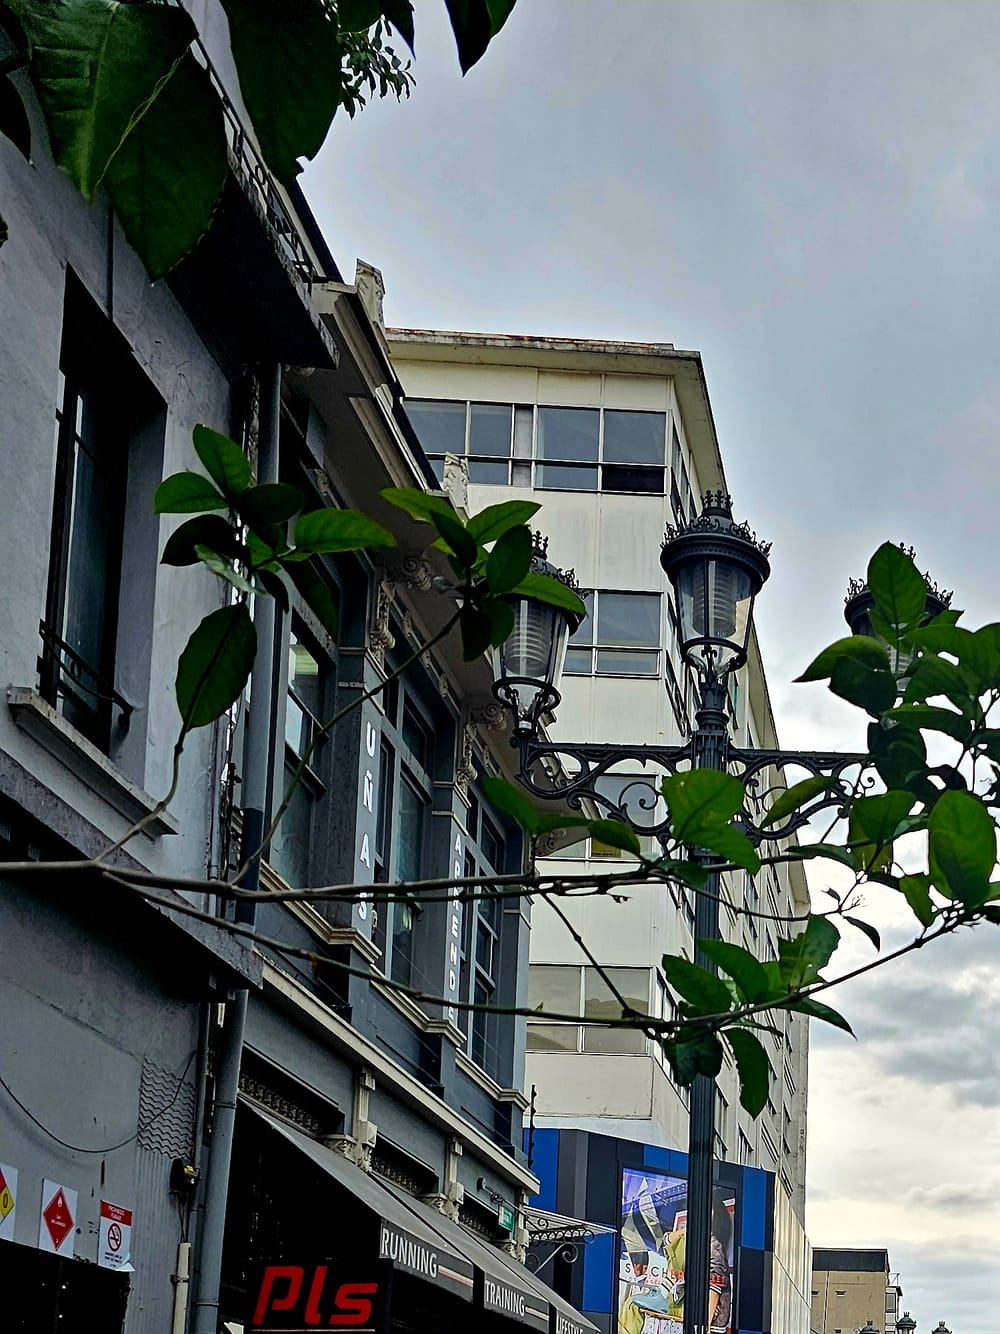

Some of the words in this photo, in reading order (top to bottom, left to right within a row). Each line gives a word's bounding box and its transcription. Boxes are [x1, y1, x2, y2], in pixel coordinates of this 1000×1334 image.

[381, 1227, 438, 1279] RUNNING
[252, 1266, 378, 1325] Pls
[485, 1280, 527, 1317] TRAINING
